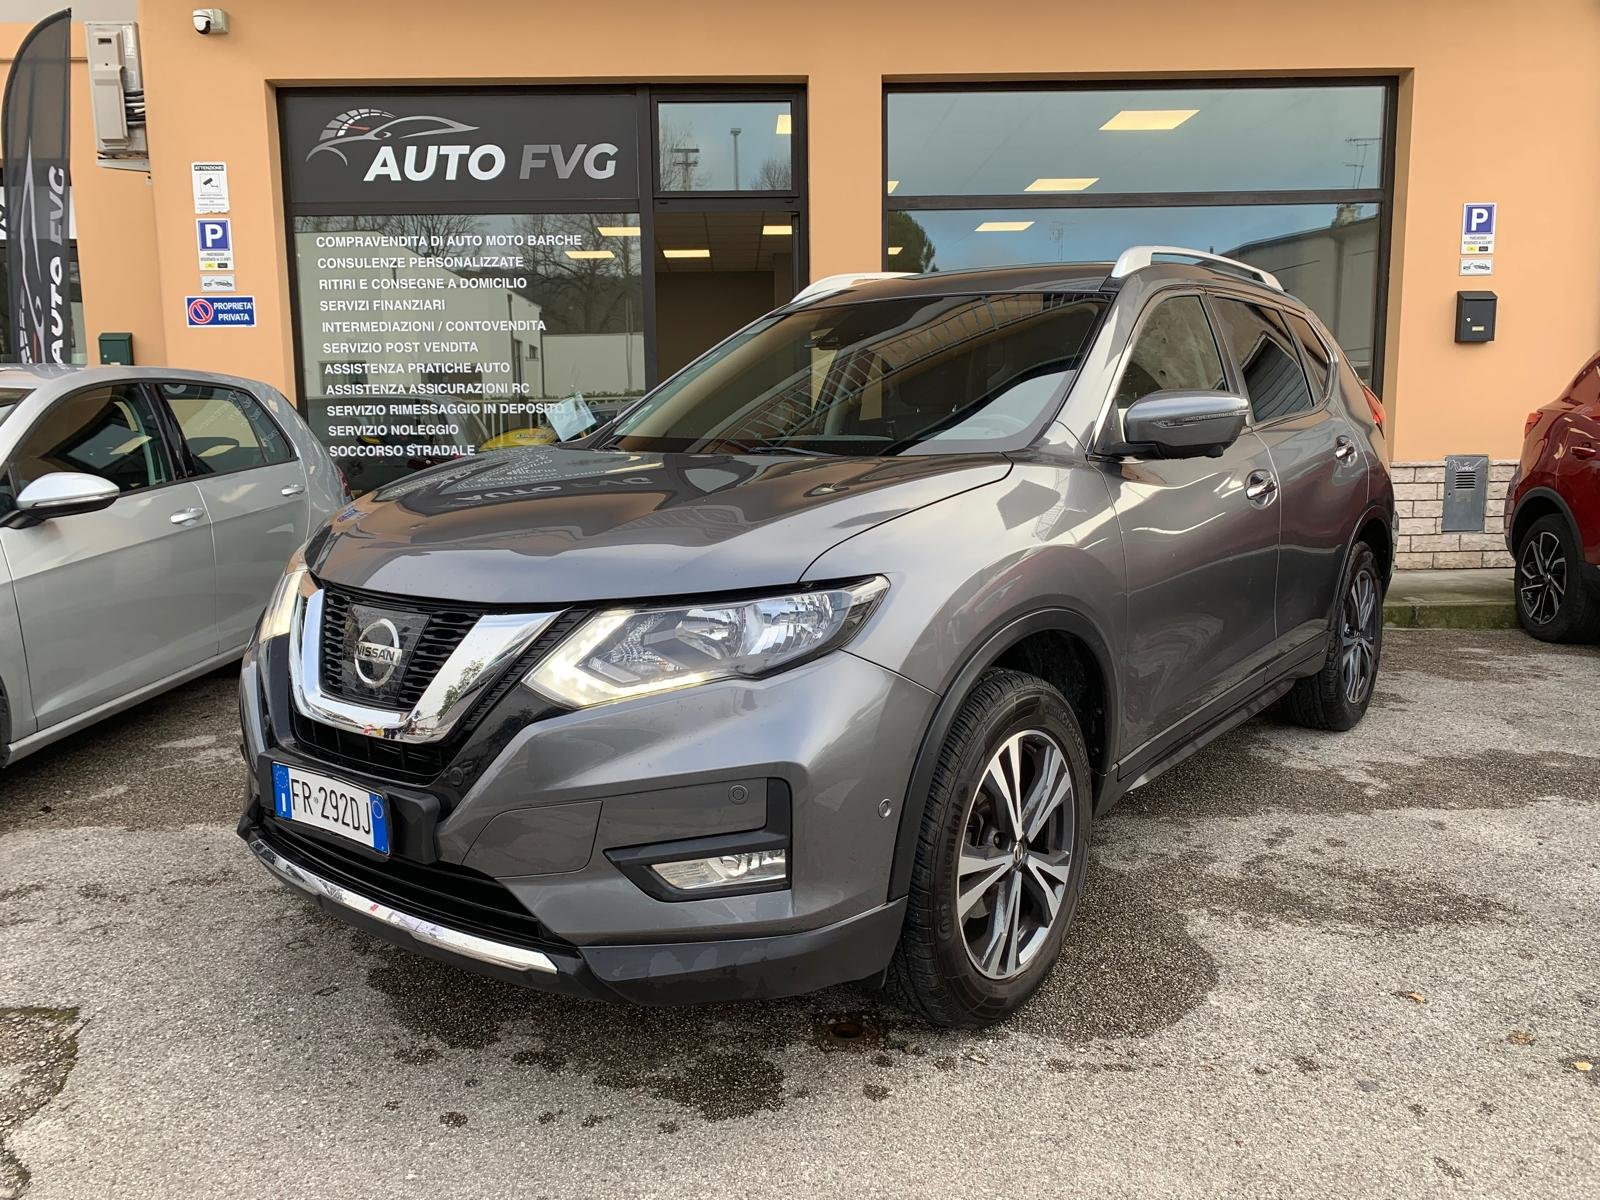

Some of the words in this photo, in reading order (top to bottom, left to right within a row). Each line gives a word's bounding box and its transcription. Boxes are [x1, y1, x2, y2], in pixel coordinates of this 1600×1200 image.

[363, 144, 506, 182] AUTO
[519, 143, 619, 180] FVG
[49, 165, 65, 246] FVG
[1470, 208, 1489, 232] P
[204, 223, 224, 248] P
[316, 236, 428, 248] COMPRAVENDITA
[430, 235, 444, 247] DI
[447, 235, 482, 246] AUTO
[486, 235, 524, 246] MOTO
[527, 234, 582, 246] BARCHE
[317, 257, 406, 269] CONSULENZE
[409, 256, 524, 268] PERSONALIZZATE
[319, 279, 356, 290] RITIRI
[359, 279, 368, 290] E
[371, 278, 445, 290] CONSEGNE
[447, 278, 457, 289] A
[460, 277, 527, 289] DOMICILIO
[50, 256, 64, 364] AUTO
[320, 300, 370, 312] SERVIZI
[373, 299, 446, 311] FINANZIARI
[218, 313, 250, 321] PRIVATA
[322, 321, 435, 333] INTERMEDIAZIONI
[437, 321, 443, 332] /
[446, 320, 547, 332] CONTOVENDITA
[323, 342, 382, 354] SERVIZIO
[385, 342, 420, 353] POST
[423, 341, 479, 353] VENDITA
[325, 363, 405, 375] ASSISTENZA
[408, 362, 472, 374] PRATICHE
[475, 362, 511, 373] AUTO
[326, 384, 406, 395] ASSISTENZA
[409, 383, 508, 395] ASSICURAZIONI
[511, 383, 530, 394] RC
[327, 405, 386, 416] SERVIZIO
[389, 403, 480, 415] RIMESSAGGIO
[484, 403, 496, 414] IN
[500, 403, 565, 414] DEPOSITO
[328, 425, 388, 436] SERVIZIO
[390, 424, 459, 435] NOLEGGIO
[329, 445, 403, 457] SOCCORSO
[406, 444, 476, 456] STRADALE
[355, 645, 396, 662] NISSAN
